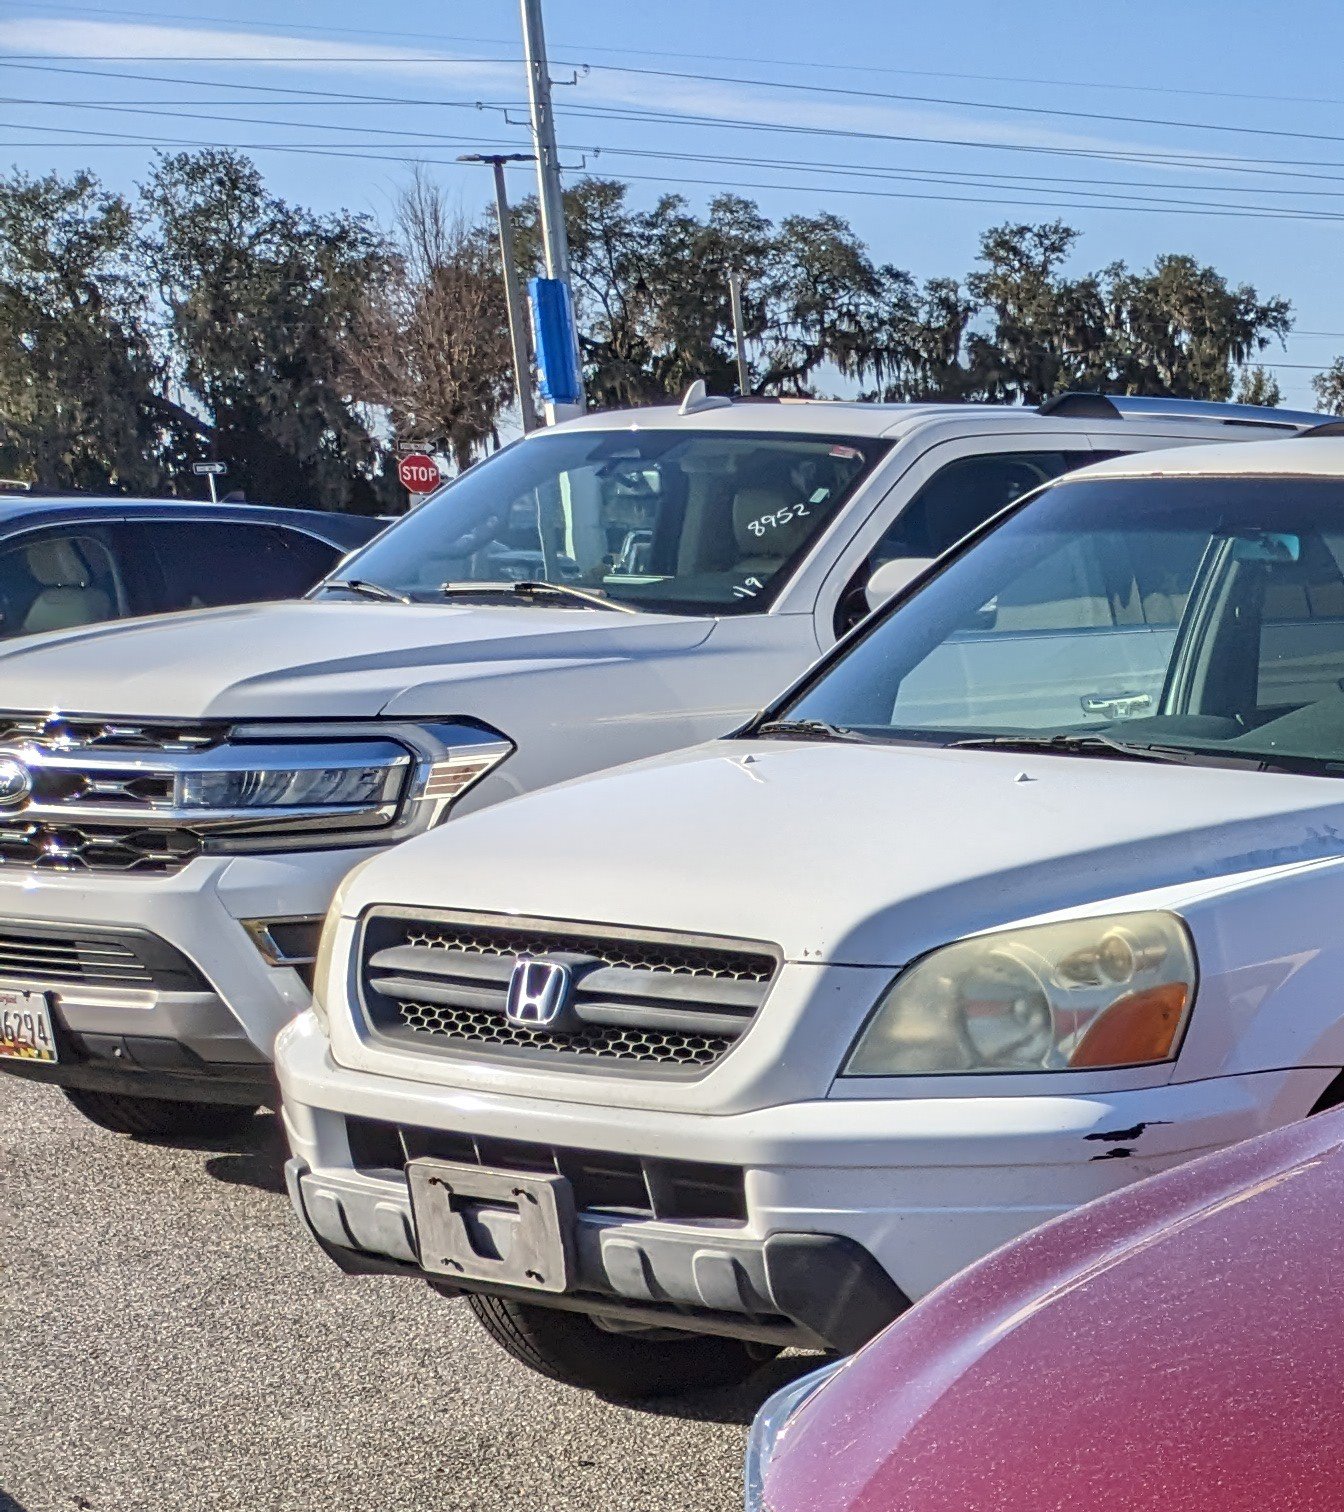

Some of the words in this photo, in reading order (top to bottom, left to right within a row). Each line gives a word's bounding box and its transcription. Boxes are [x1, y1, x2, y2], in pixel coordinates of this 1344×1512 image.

[402, 465, 437, 481] STOP
[747, 503, 811, 537] 8952
[0, 1009, 49, 1048] 6294
